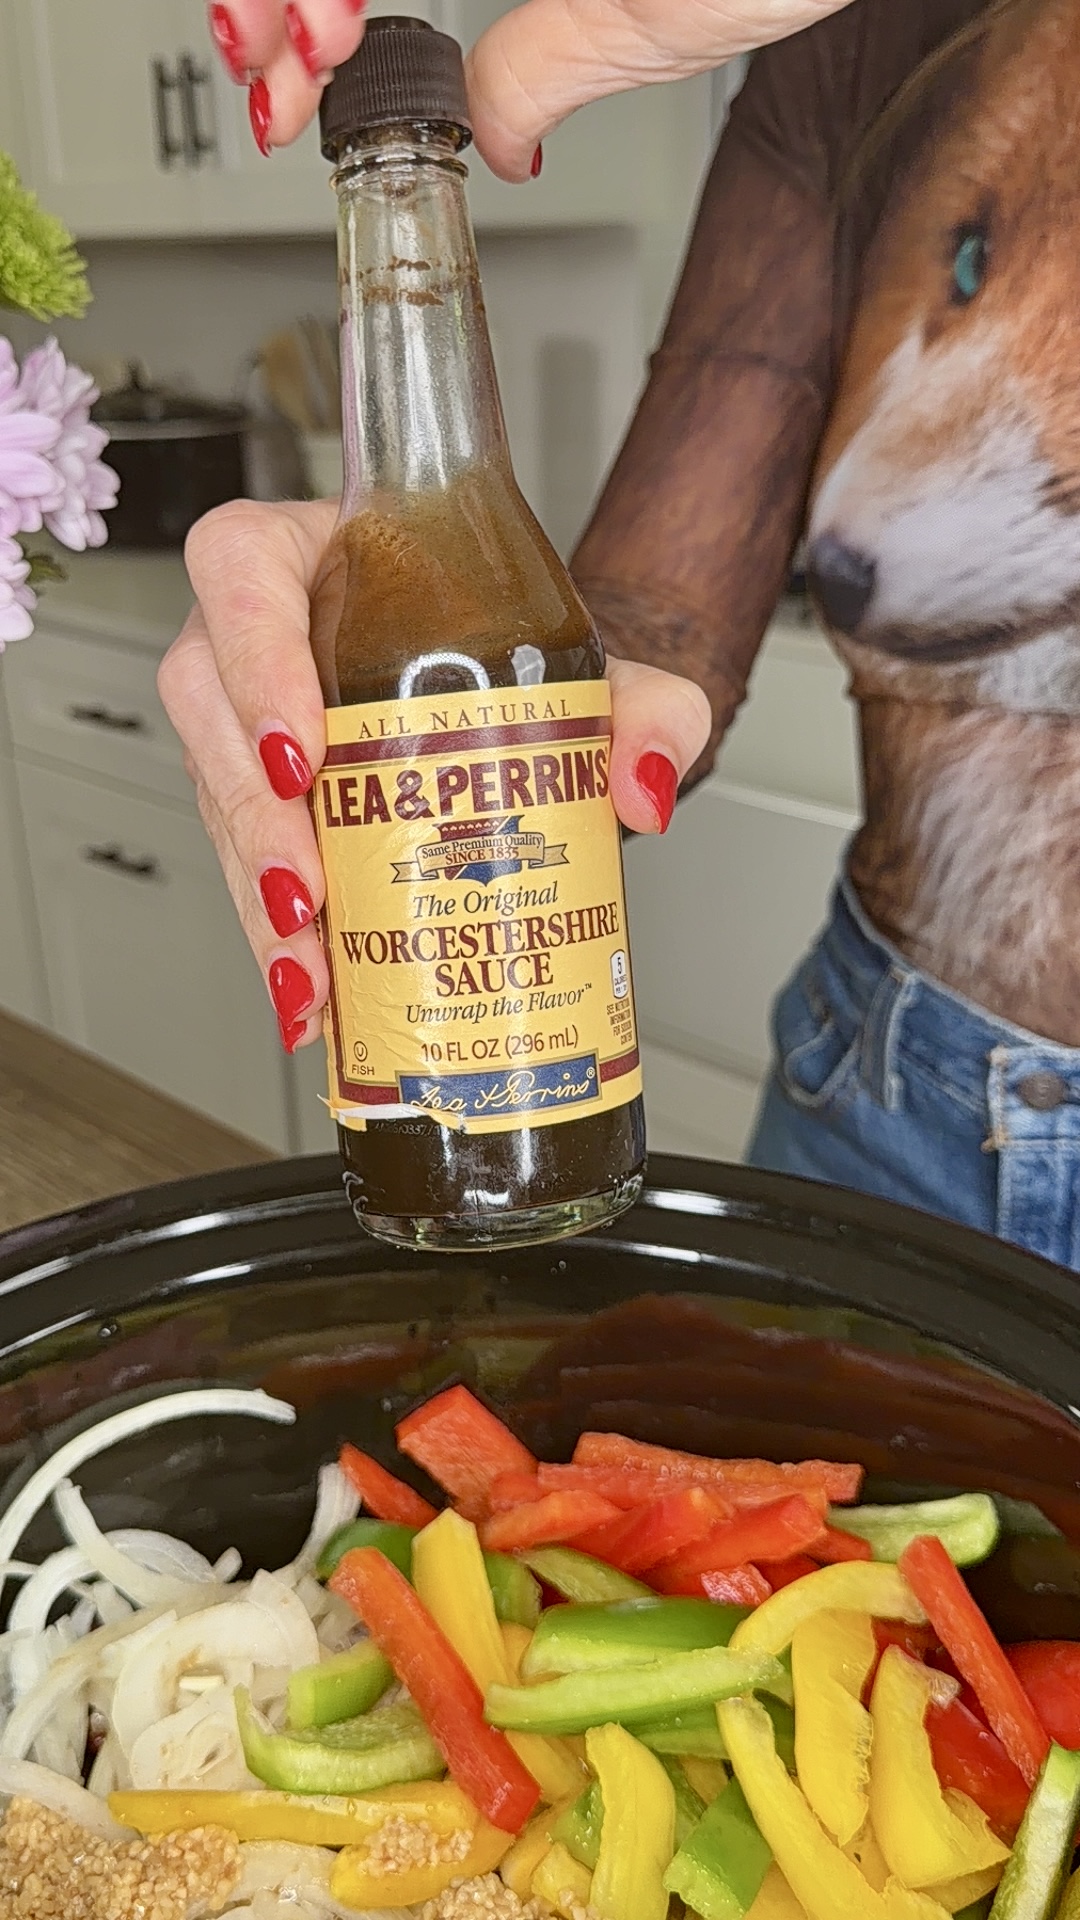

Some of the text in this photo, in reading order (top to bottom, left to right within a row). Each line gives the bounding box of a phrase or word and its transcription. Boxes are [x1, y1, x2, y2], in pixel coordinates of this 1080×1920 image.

[358, 699, 571, 739] ALL NATURAL
[421, 834, 543, 859] Same Premium Quality
[445, 847, 520, 865] SINCE 1835
[413, 880, 559, 919] The Original
[340, 901, 620, 965] WORCESTERSHIRE
[435, 952, 554, 998] SAUCE
[405, 1001, 488, 1025] Unwrap
[492, 996, 523, 1016] the
[420, 1024, 579, 1062] 10 FL OZ (296 mL)
[351, 1065, 375, 1076] FISH
[410, 1086, 468, 1111] Lea
